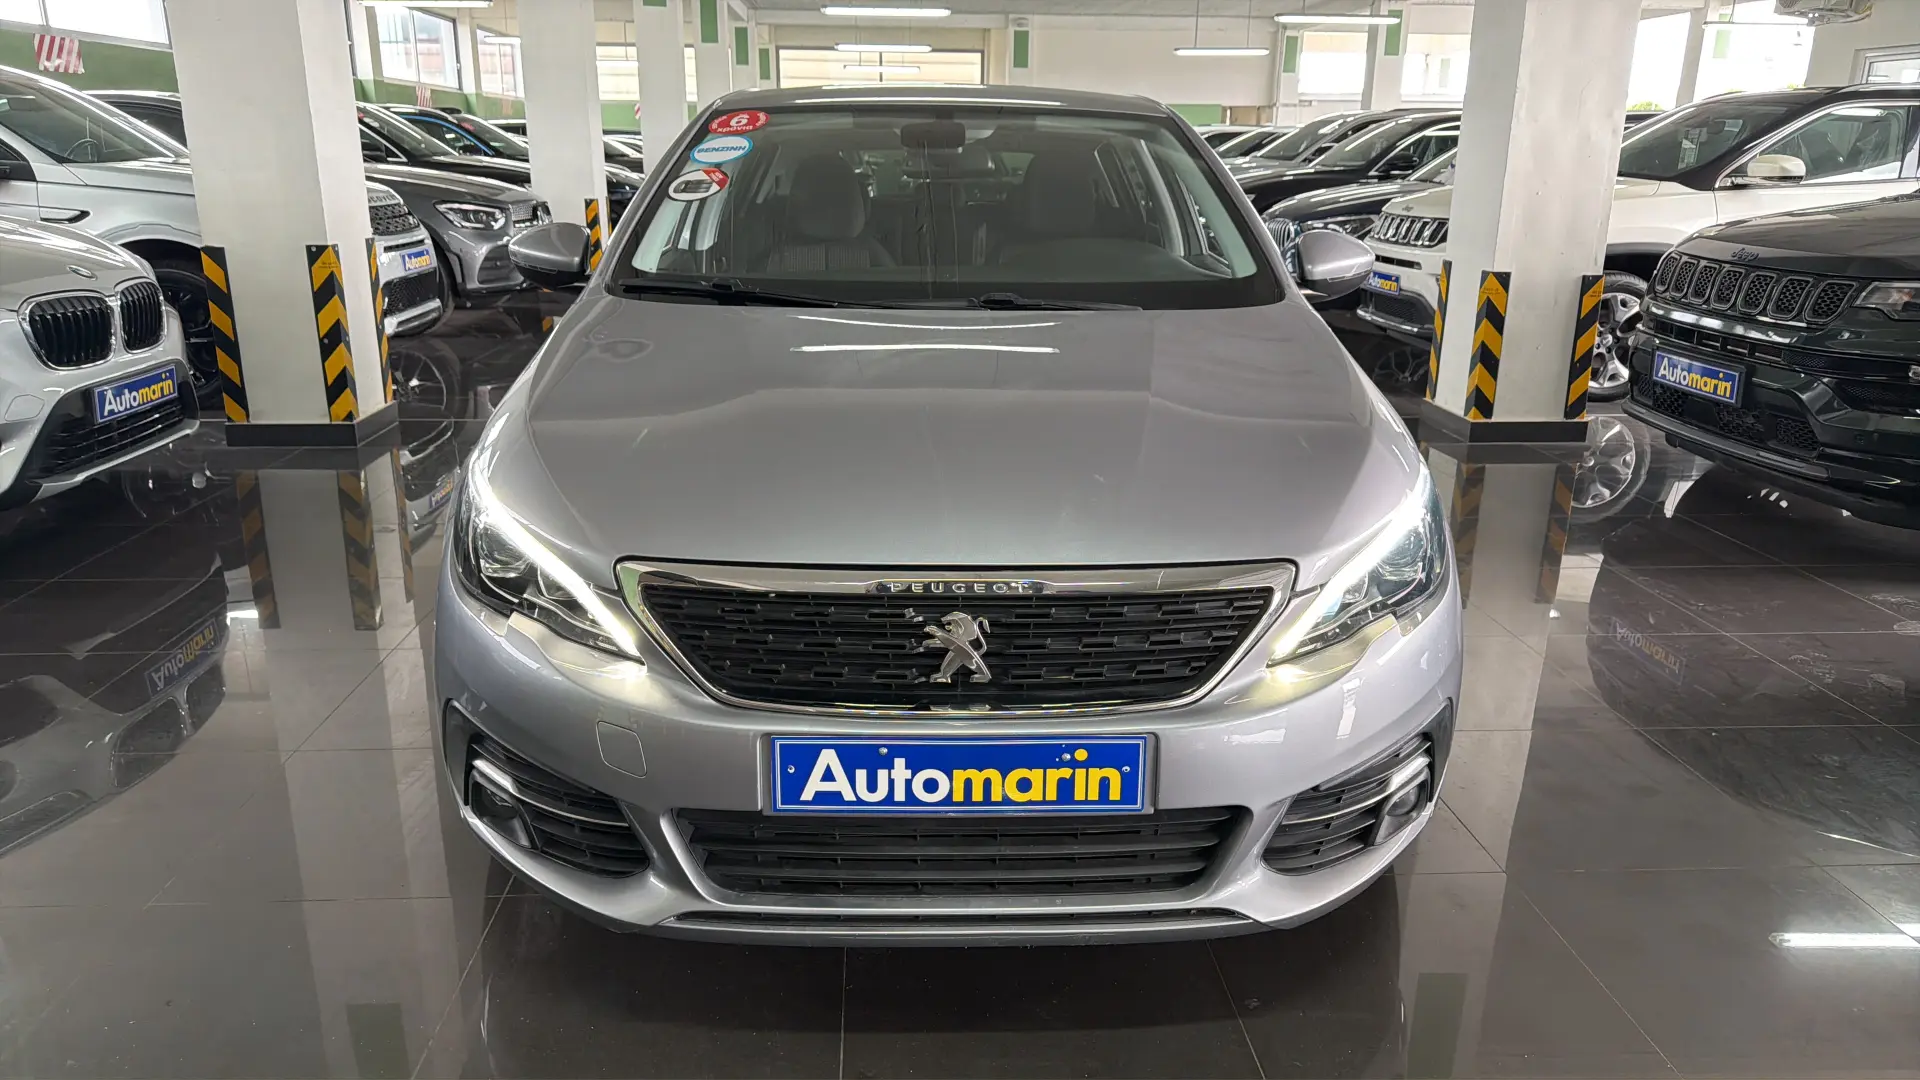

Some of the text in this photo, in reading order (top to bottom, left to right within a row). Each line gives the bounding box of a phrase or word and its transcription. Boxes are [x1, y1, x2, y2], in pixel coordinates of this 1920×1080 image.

[730, 112, 750, 127] 6
[1731, 247, 1760, 261] Jeep
[1658, 356, 1732, 398] Automarin
[103, 372, 174, 417] Automarin
[886, 581, 1029, 593] PEUGEOT
[799, 748, 1122, 803] Automarin
